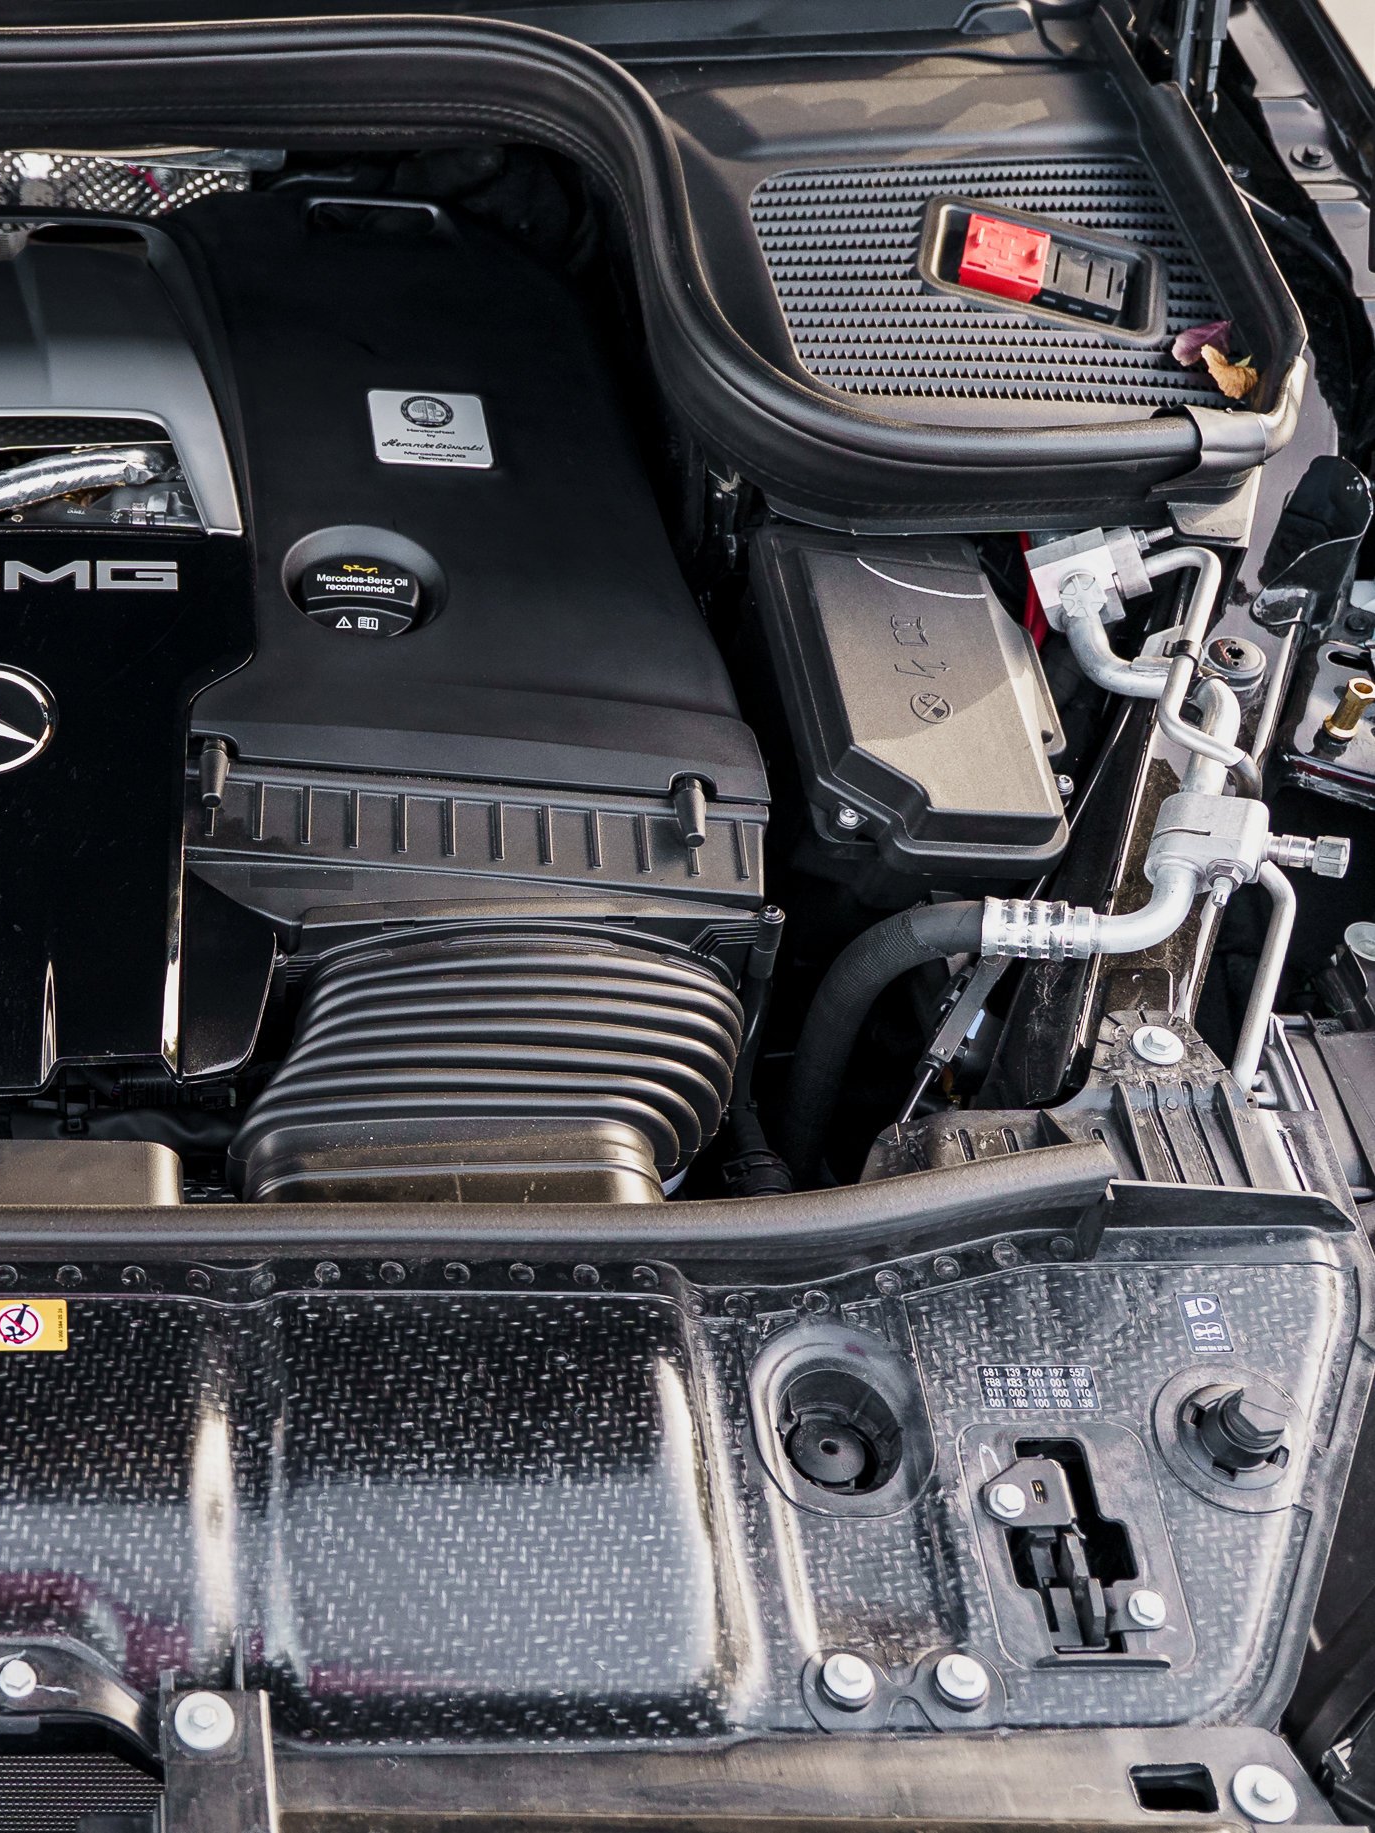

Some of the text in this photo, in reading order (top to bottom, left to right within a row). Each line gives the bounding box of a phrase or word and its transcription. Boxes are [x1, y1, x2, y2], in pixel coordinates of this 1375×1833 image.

[316, 573, 409, 587] Mercedes-Benz Oil
[325, 583, 396, 594] recommended
[983, 1367, 1085, 1377] 681 139 760 197 557
[985, 1378, 1001, 1387] FB8
[1028, 1378, 1045, 1387] 011
[1050, 1378, 1066, 1387] 001
[1073, 1378, 1089, 1387] 100
[987, 1388, 1003, 1398] 011
[1009, 1388, 1025, 1398] 000
[1032, 1388, 1047, 1398] 111
[1052, 1388, 1069, 1398] 000
[989, 1399, 1094, 1408] 001 100 100 100 138
